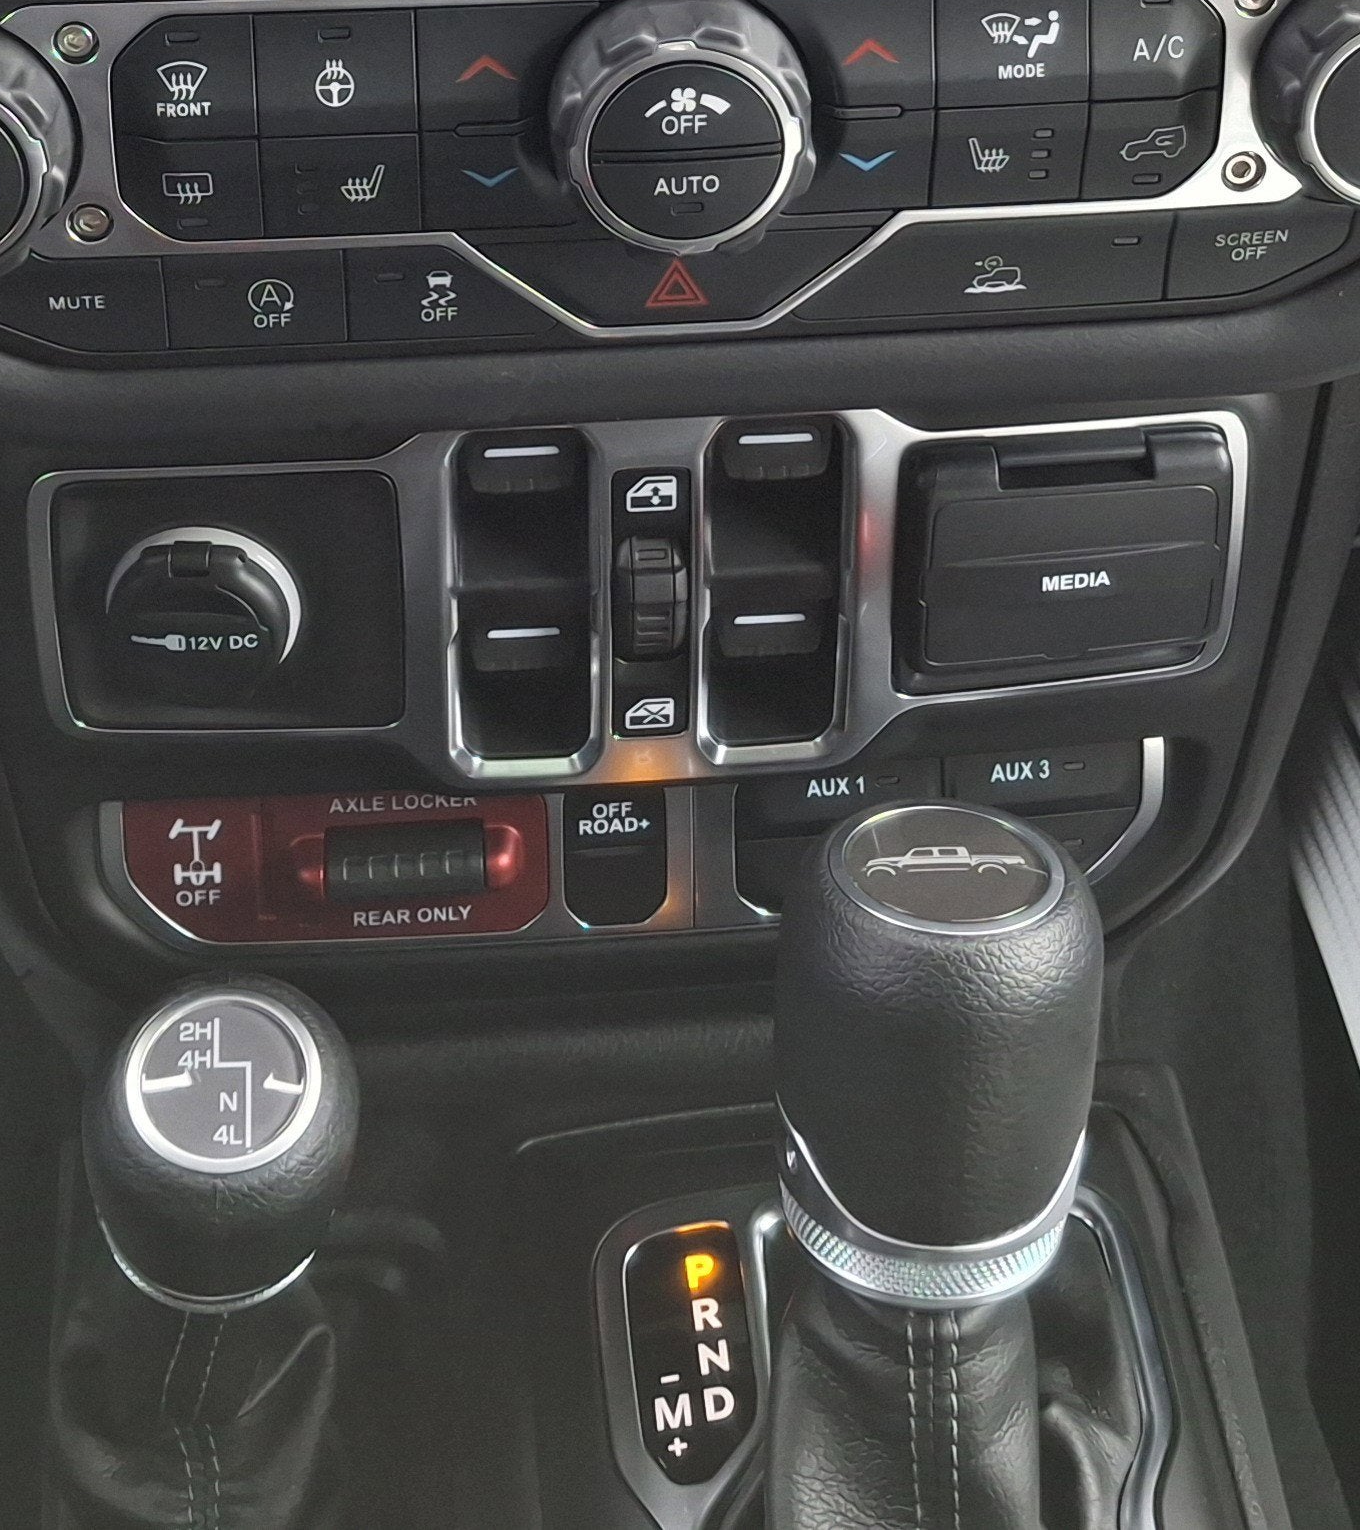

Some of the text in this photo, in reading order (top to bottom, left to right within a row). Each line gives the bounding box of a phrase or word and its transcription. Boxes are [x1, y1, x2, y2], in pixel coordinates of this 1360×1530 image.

[1133, 35, 1185, 62] A/C
[998, 63, 1045, 80] MODE
[156, 102, 212, 118] FRONT
[661, 114, 708, 135] OFF
[653, 174, 721, 197] AUTO
[1214, 228, 1289, 249] SCREEN
[1230, 245, 1268, 262] OFF
[49, 295, 106, 311] MUTE
[253, 312, 292, 329] OFF
[420, 307, 458, 323] OFF
[1041, 570, 1110, 592] MEDIA
[188, 633, 258, 652] 12V DC
[990, 760, 1050, 784] AUX 3
[806, 776, 866, 799] AUX 1
[329, 793, 478, 814] AXLE LOCKER
[592, 801, 633, 819] OFF
[176, 889, 222, 907] OFF
[353, 905, 472, 927] REAR ONLY
[179, 1021, 212, 1042] 2H
[177, 1049, 211, 1069] 4H
[219, 1091, 238, 1112] N
[212, 1124, 243, 1146] 4L
[685, 1254, 715, 1289] P
[691, 1297, 723, 1332] R
[697, 1338, 730, 1376] N
[654, 1392, 693, 1432] M
[703, 1386, 735, 1422] D
